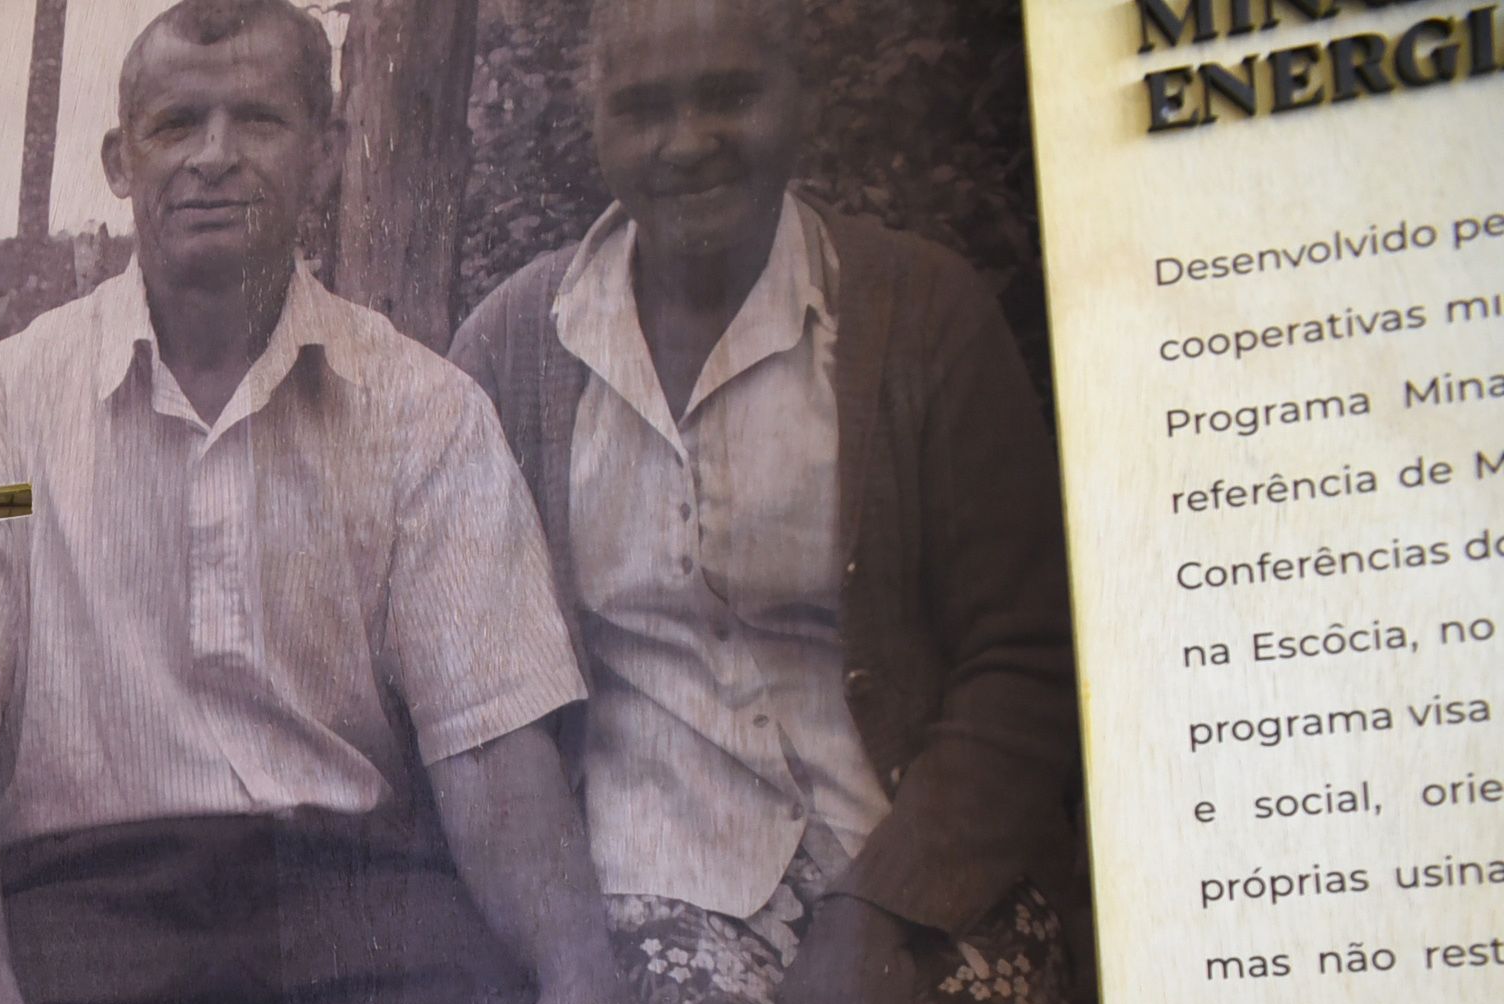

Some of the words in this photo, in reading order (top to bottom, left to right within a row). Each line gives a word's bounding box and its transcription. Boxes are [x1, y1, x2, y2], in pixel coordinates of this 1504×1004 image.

[1144, 4, 1504, 133] ENERGI
[1155, 220, 1437, 287] Desenvolvido
[1453, 213, 1504, 250] pe
[1159, 305, 1427, 362] cooperativas
[1166, 392, 1371, 438] Programa
[1404, 372, 1504, 409] Mina
[1171, 464, 1378, 515] referência
[1398, 456, 1453, 489] de
[1176, 538, 1451, 591] Conferências
[1183, 642, 1231, 668] na
[1440, 618, 1495, 644] no
[1189, 707, 1393, 753] programa
[1407, 694, 1491, 727] visa
[1193, 800, 1217, 824] e
[1254, 780, 1382, 820] social,
[1421, 772, 1504, 807] orie
[1200, 863, 1370, 910] próprias
[1395, 854, 1504, 890] usina
[1206, 953, 1292, 981] mas
[1318, 941, 1397, 975] não
[1425, 938, 1504, 970] rest
